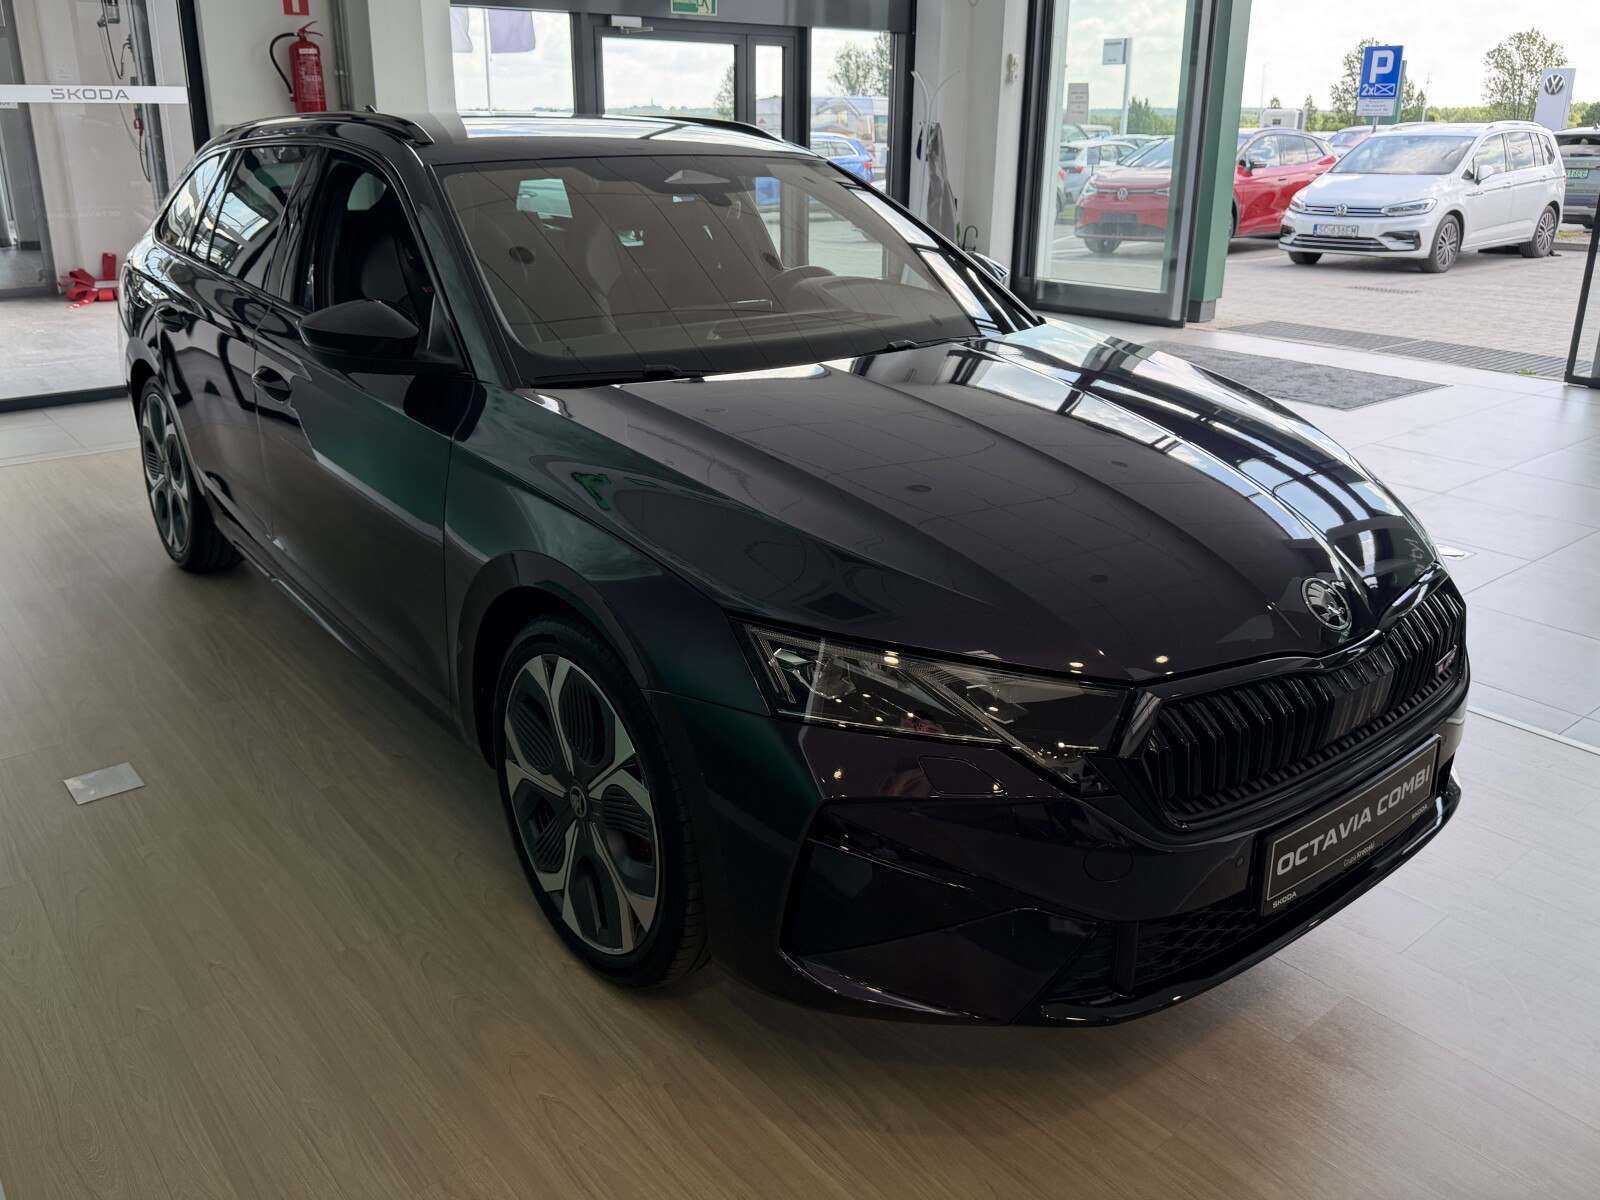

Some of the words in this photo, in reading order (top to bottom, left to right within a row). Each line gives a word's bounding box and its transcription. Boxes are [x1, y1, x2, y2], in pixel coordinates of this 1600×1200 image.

[1369, 49, 1395, 83] P
[1276, 805, 1372, 876] OCTAVIA
[1376, 764, 1431, 817] COMBI
